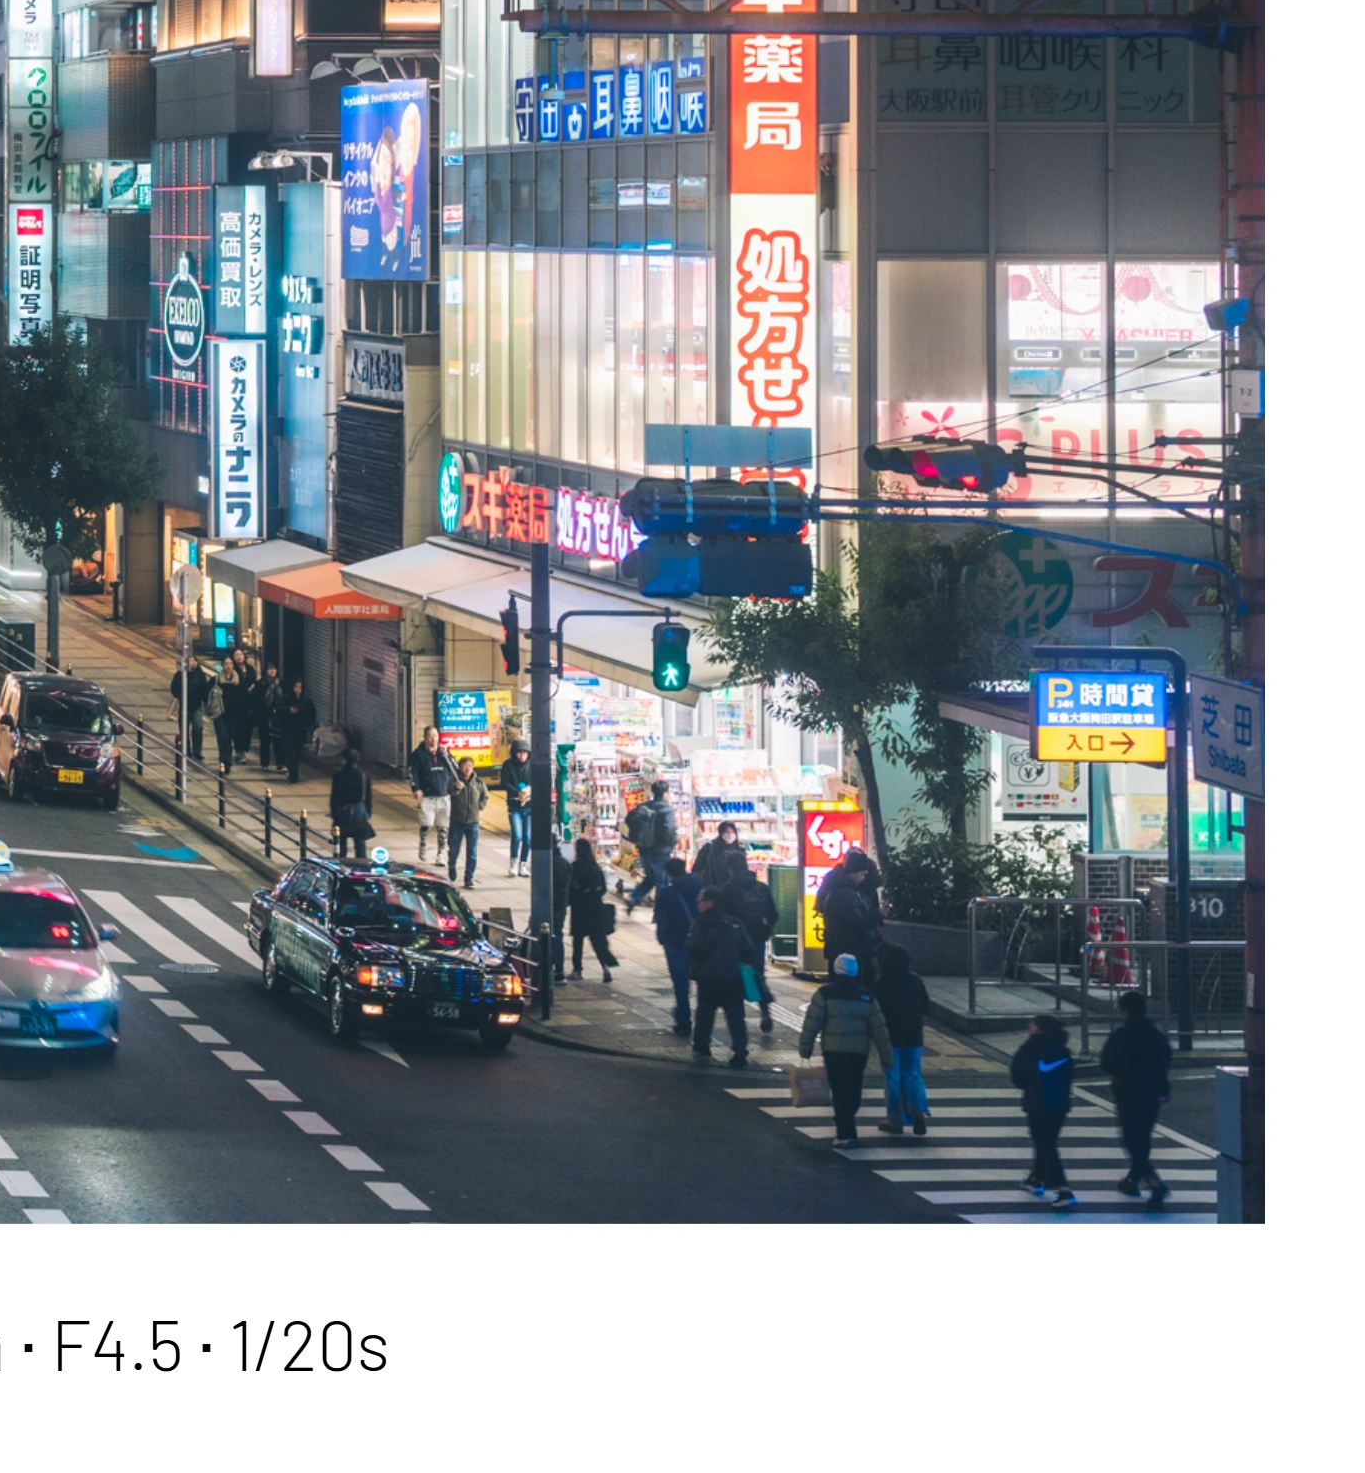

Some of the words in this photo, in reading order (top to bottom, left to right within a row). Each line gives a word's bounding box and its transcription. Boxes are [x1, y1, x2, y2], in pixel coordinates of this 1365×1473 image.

[220, 212, 242, 308] 高価買取
[737, 228, 810, 426] 処方せ
[225, 446, 252, 528] ナニワ
[463, 468, 550, 546] スギ薬局
[1048, 678, 1073, 709] P
[1080, 682, 1155, 708] 時間貸
[1200, 693, 1252, 747] 芝田
[1066, 733, 1104, 752] 入口
[1208, 743, 1247, 779] Shibata
